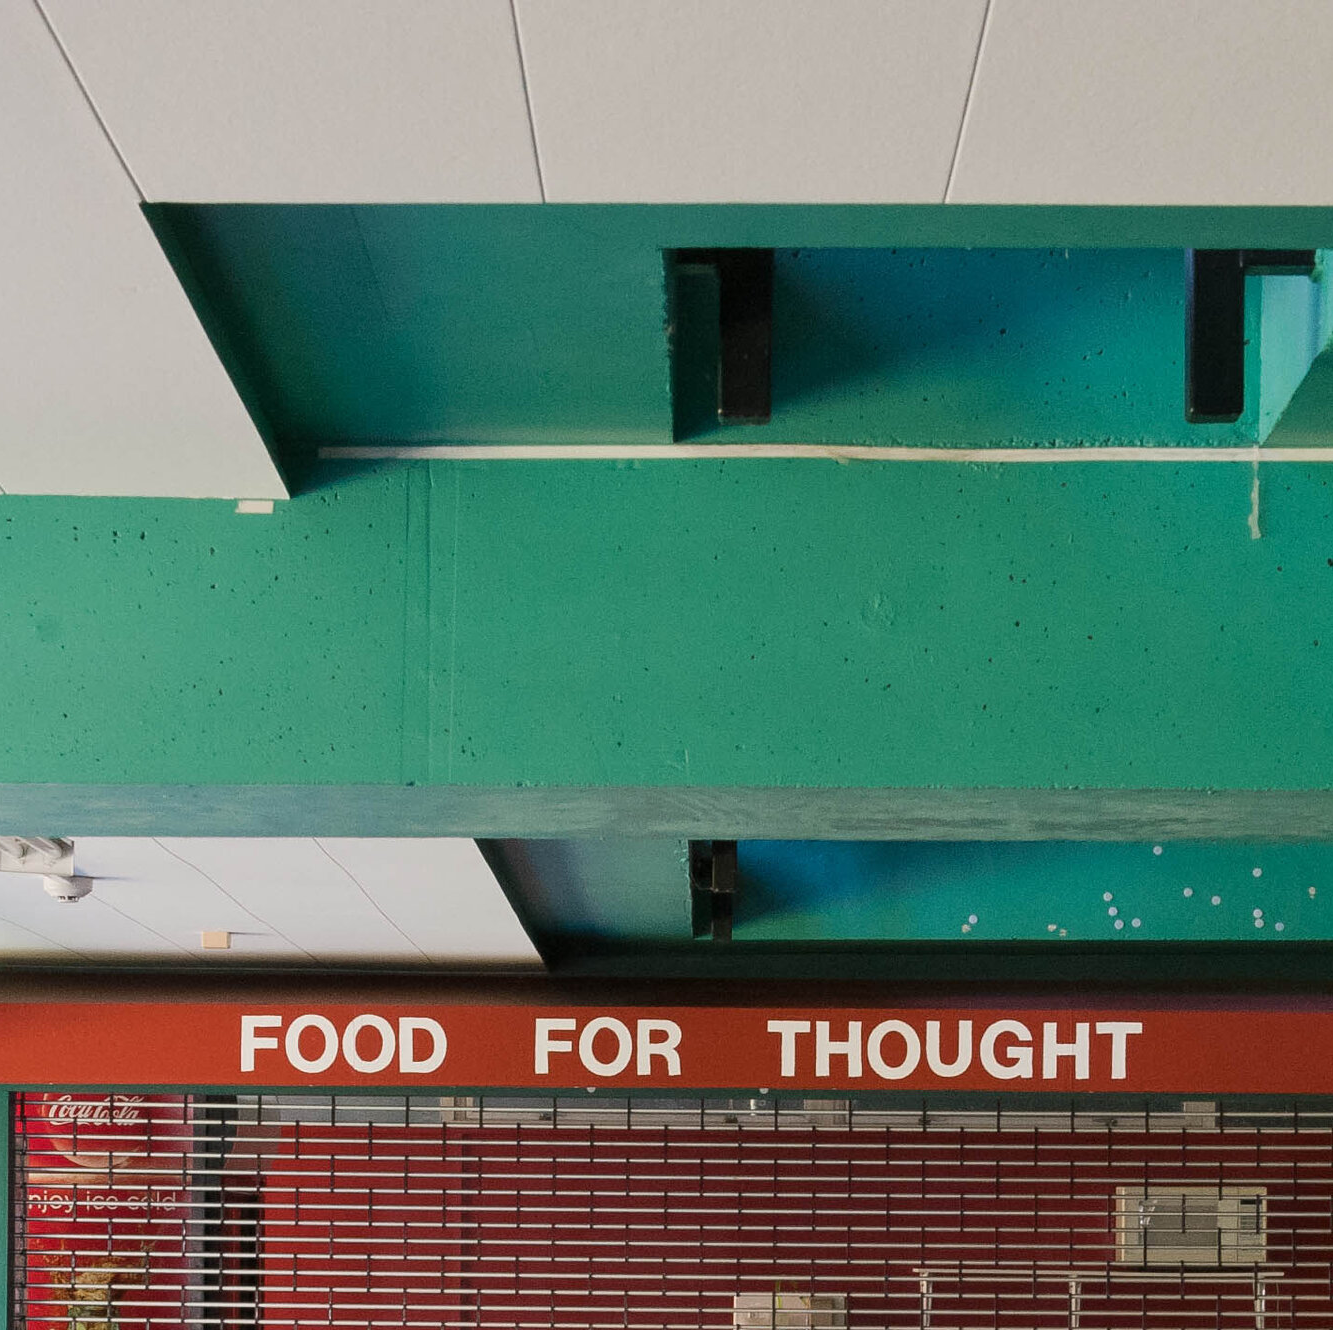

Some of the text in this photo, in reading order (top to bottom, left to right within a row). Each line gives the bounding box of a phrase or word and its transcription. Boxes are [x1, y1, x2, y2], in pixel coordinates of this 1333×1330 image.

[240, 1013, 1144, 1080] FOOD FOR THOUGHT
[28, 1190, 177, 1214] njoy ice cold
